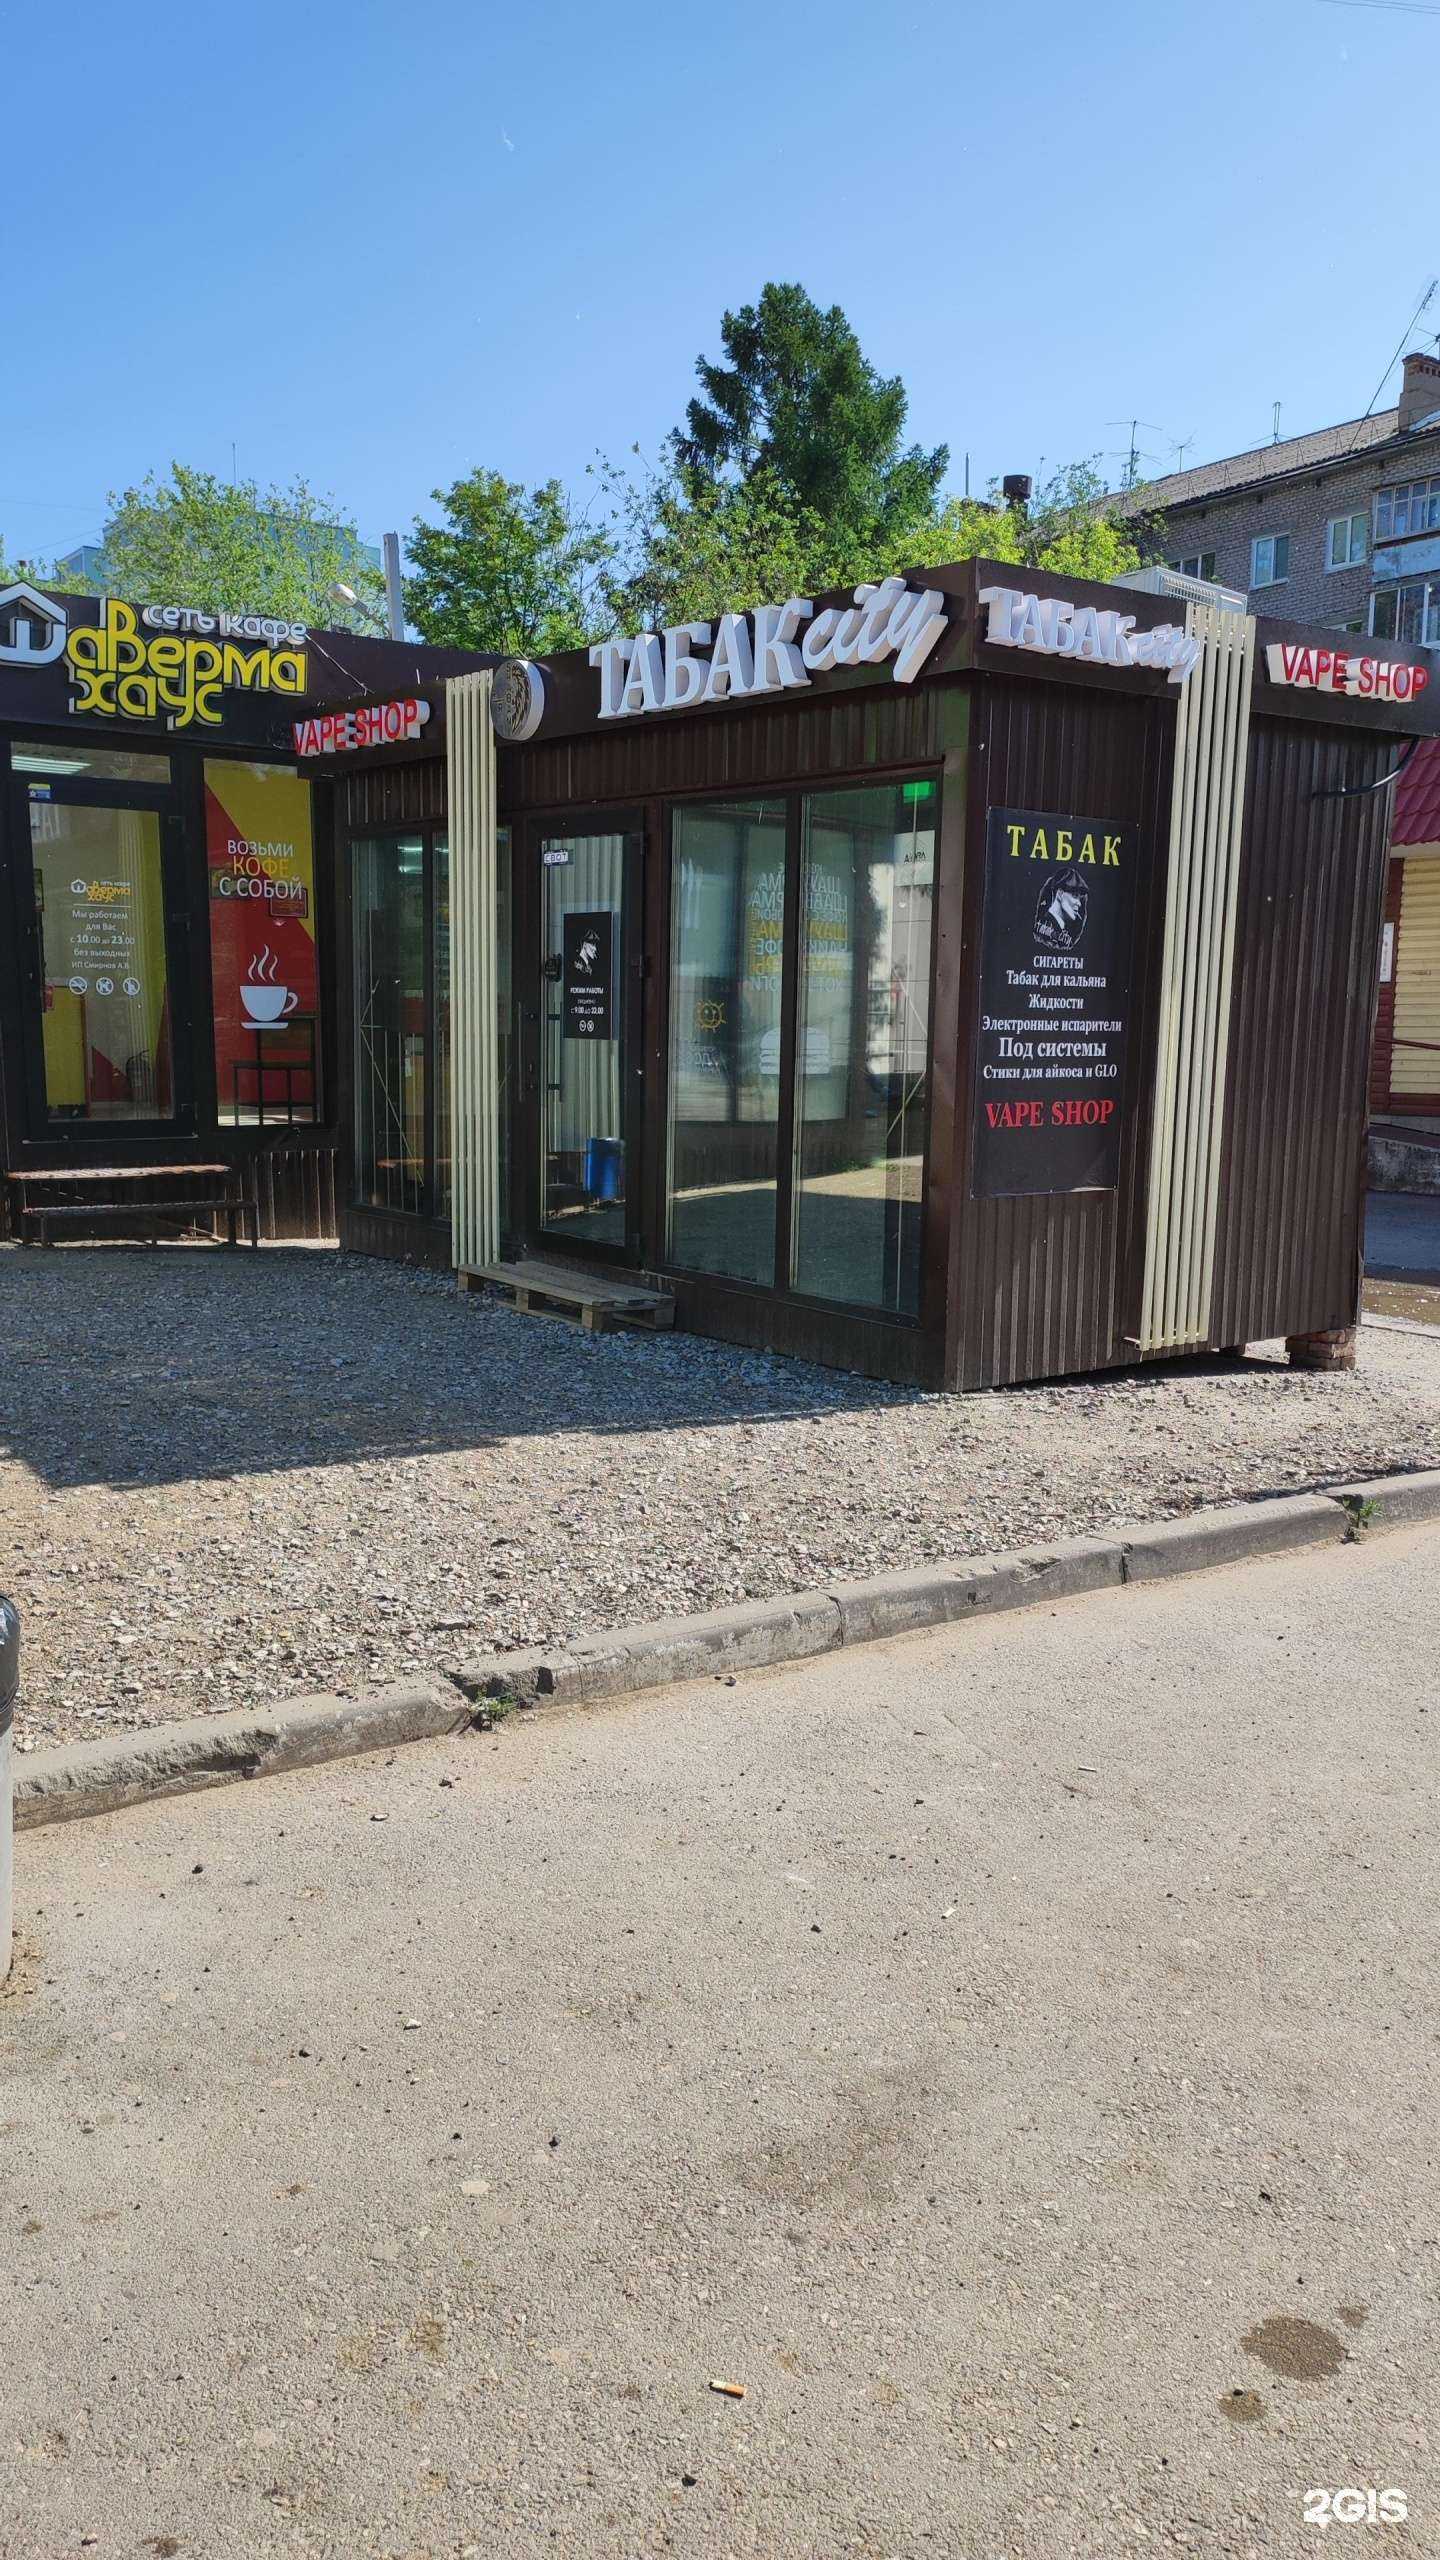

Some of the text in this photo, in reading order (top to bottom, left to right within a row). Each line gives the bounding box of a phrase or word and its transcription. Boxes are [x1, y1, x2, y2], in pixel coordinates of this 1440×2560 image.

[144, 604, 308, 648] сеть кафе
[979, 586, 1136, 667] ТАБАК
[589, 599, 812, 719] ТАБАК
[1270, 643, 1430, 702] VAPE SHOP
[73, 669, 224, 729] хаус
[293, 698, 428, 757] VAPE SHOP
[227, 839, 294, 857] ВОЗЬМИ
[1007, 825, 1122, 866] ТАБАК
[232, 856, 290, 878] КОФЕ
[219, 874, 303, 900] С СОБОЙ
[72, 910, 129, 920] Мы работаем
[86, 923, 100, 931] для
[74, 948, 130, 958] без выходных
[1033, 955, 1084, 970] СИГАРЕТЫ
[1006, 969, 1107, 988] Табак для кальяна
[1028, 993, 1084, 1011] Жидкости
[982, 1015, 1123, 1035] Электронные испарители
[998, 1037, 1108, 1060] Под системы
[983, 1063, 1118, 1080] Стики для айкоса и GLO
[985, 1099, 1115, 1129] VAPE SHOP
